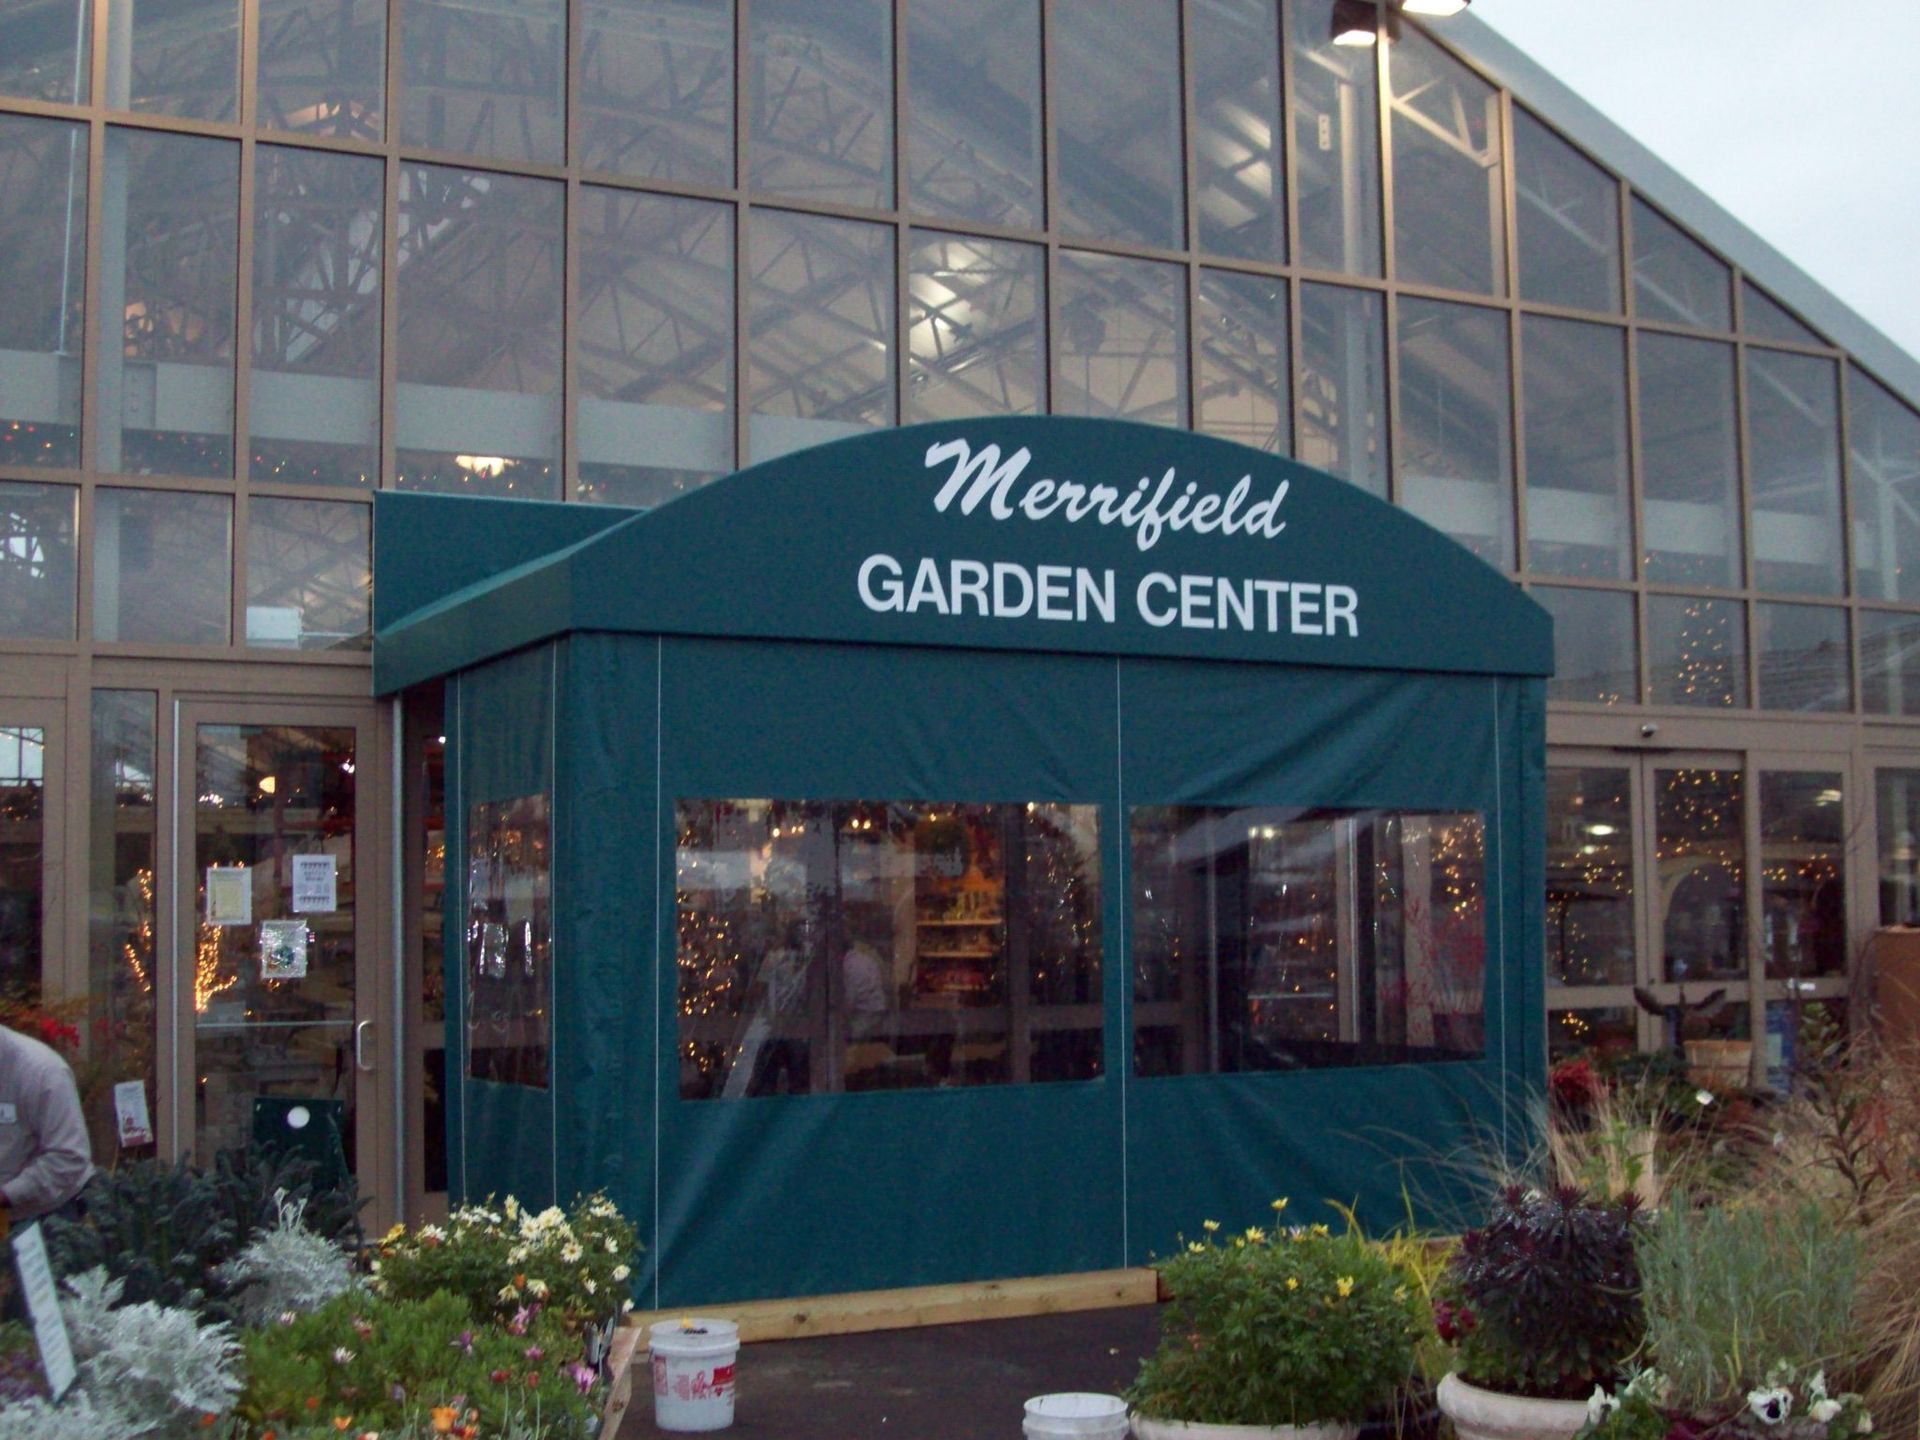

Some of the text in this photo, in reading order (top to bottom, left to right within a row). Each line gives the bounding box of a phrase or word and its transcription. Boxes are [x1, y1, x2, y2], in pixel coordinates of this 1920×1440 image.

[924, 438, 1290, 552] Merrifield
[857, 553, 1359, 637] GARDEN CENTER
